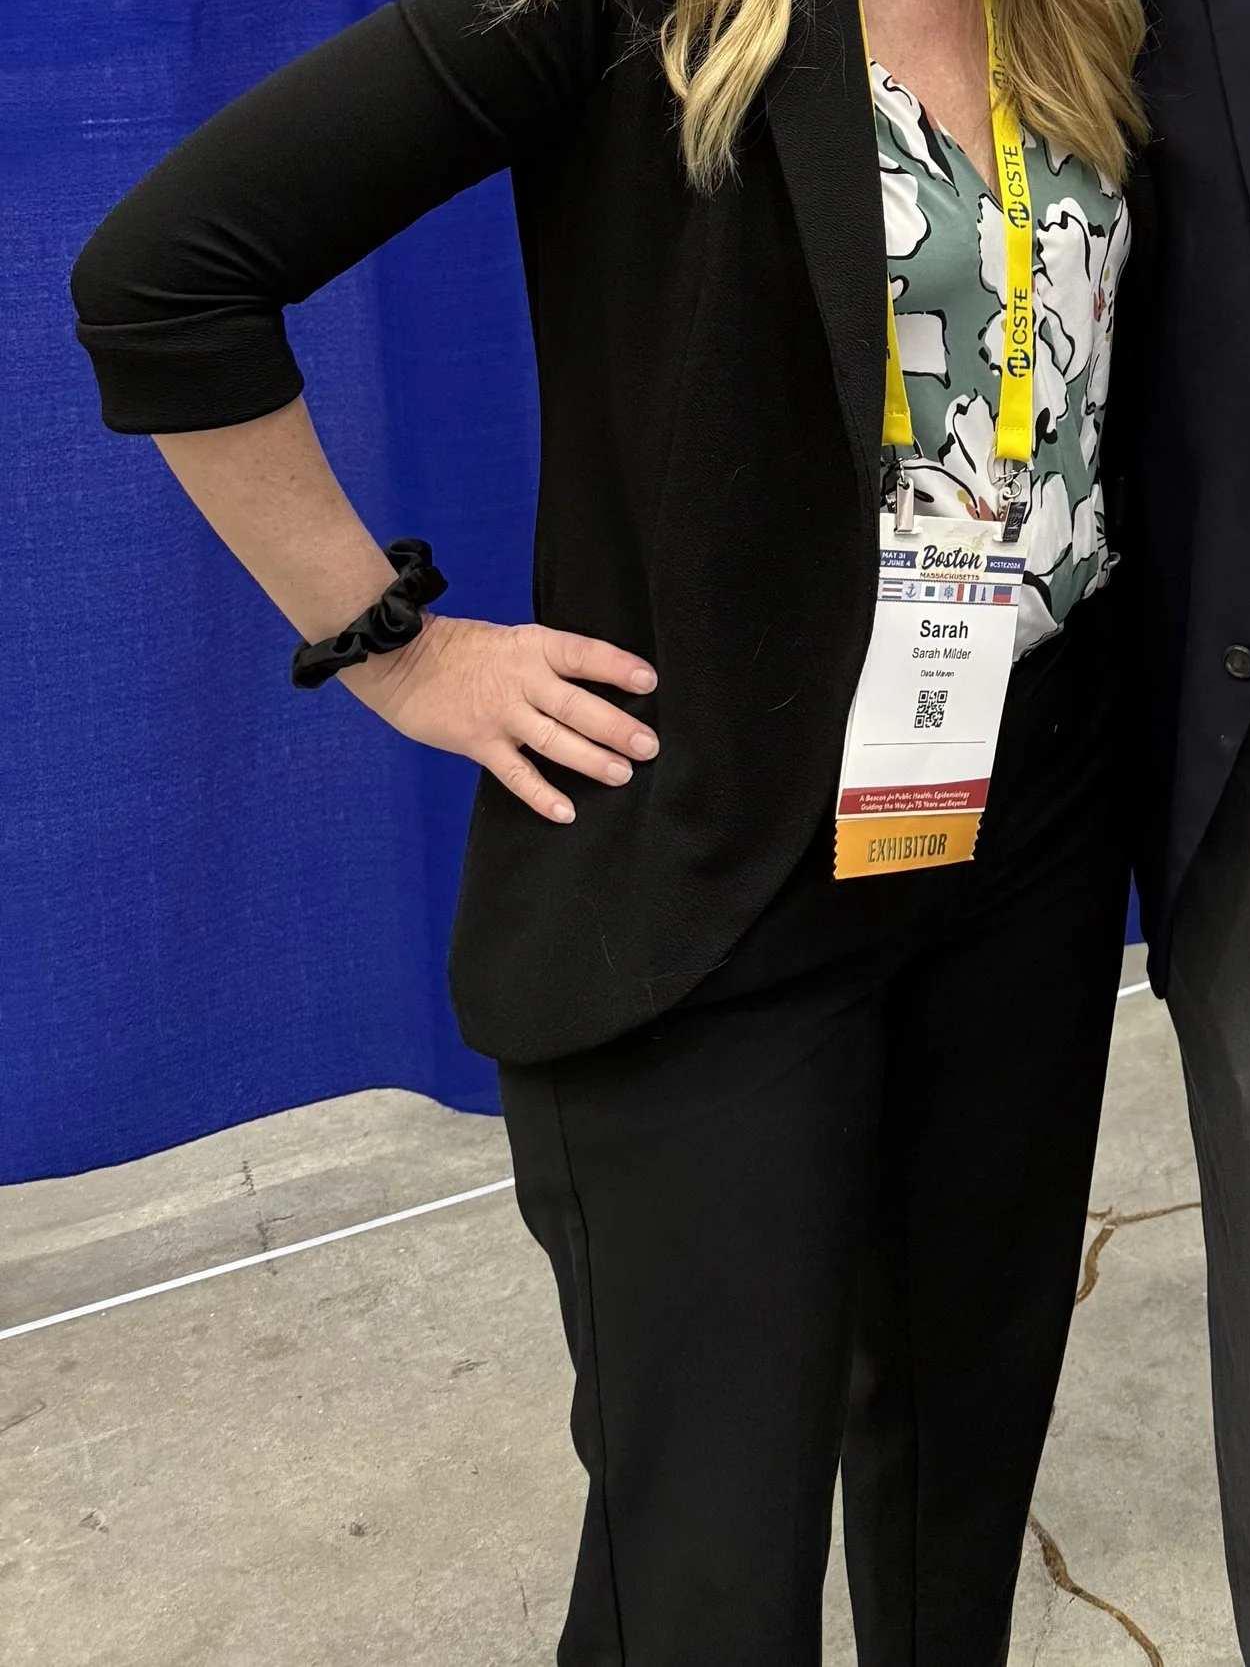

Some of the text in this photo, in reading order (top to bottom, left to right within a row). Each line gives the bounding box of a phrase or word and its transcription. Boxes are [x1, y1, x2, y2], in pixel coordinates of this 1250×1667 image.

[1003, 144, 1025, 197] CSTE
[1012, 287, 1028, 344] CSTE
[882, 551, 898, 559] MAY
[921, 544, 983, 571] Boston
[905, 559, 911, 567] 4
[920, 572, 980, 581] MASSACHUSETTS
[919, 619, 969, 639] Sarah
[912, 647, 972, 660] Sarah Milder
[920, 669, 955, 677] Data Maven
[865, 794, 887, 802] Beacon
[895, 792, 912, 800] Public
[934, 791, 970, 800] Epidemiology
[860, 803, 883, 811] Guiding
[894, 802, 906, 810] Way
[923, 800, 938, 808] Years
[947, 799, 968, 807] Beyond
[867, 832, 948, 863] EXHIBITOR
